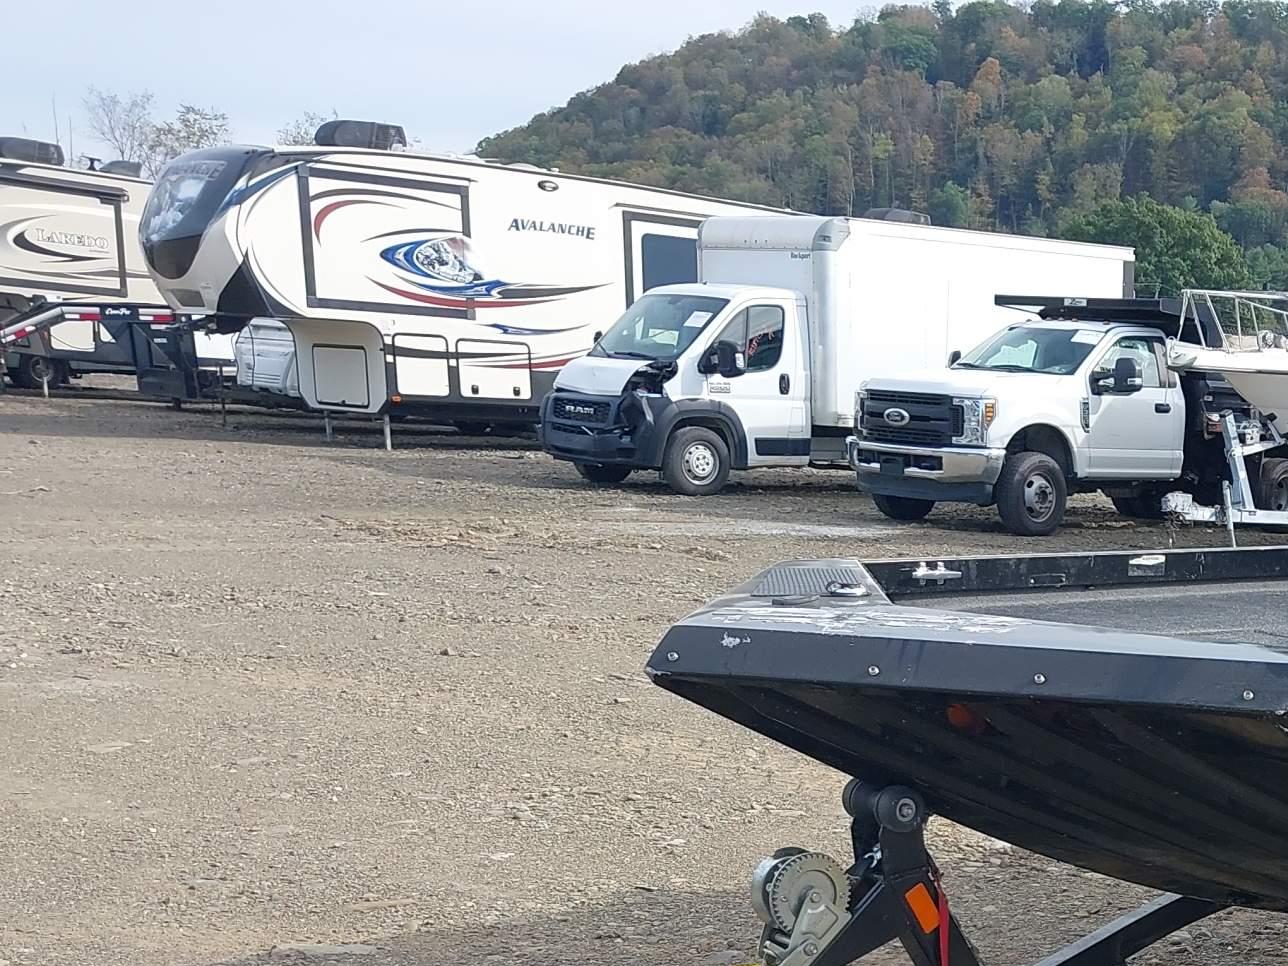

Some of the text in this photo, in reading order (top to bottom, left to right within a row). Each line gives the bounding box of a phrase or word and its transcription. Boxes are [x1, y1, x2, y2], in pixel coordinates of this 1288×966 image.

[35, 228, 109, 249] LAREDO
[508, 218, 596, 240] AVALANCHE
[565, 405, 595, 414] RAM
